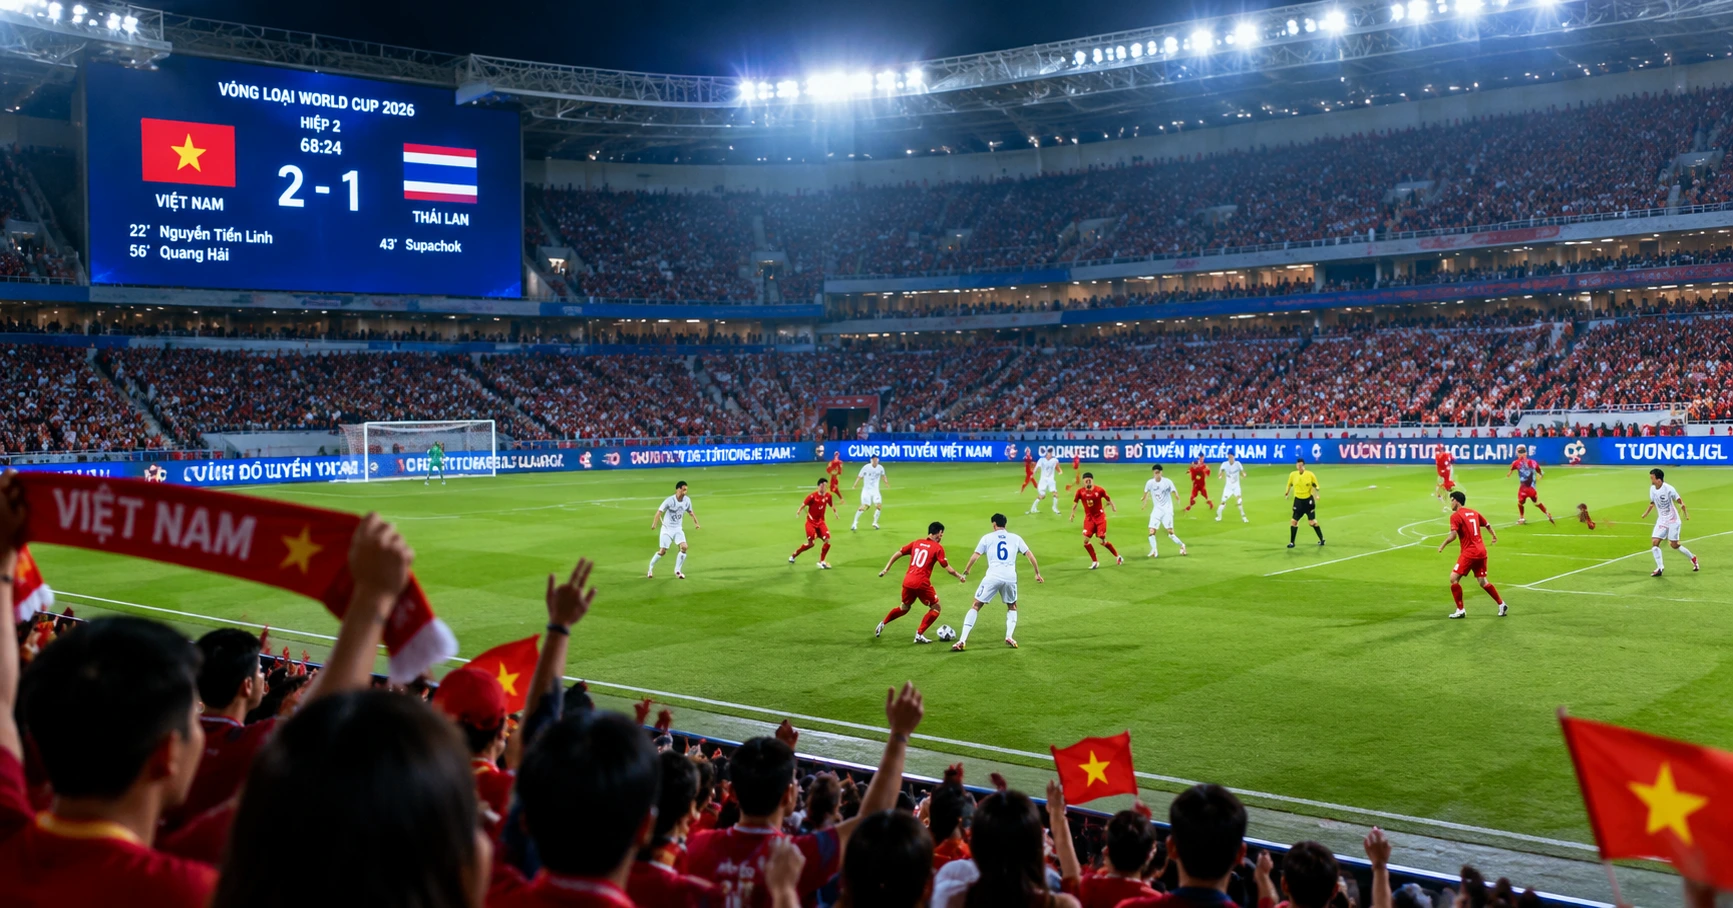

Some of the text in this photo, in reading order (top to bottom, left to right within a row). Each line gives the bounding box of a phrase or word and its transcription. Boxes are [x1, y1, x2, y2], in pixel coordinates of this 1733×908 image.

[263, 86, 295, 106] LOẠI
[298, 91, 348, 109] WORLD
[351, 97, 379, 113] CUP
[382, 100, 415, 117] 2026
[300, 114, 341, 133] HIỆP 2
[300, 137, 342, 156] 68:24
[278, 164, 359, 212] 2 - 1
[155, 191, 224, 212] VIỆT NAM
[412, 208, 469, 226] THÁI LAN
[245, 230, 273, 244] Linh
[405, 238, 462, 254] Supachok
[159, 245, 204, 263] Quang
[965, 445, 993, 458] NAM
[53, 484, 257, 561] VIỆT NAM
[911, 548, 928, 568] 10
[996, 540, 1009, 561] 6
